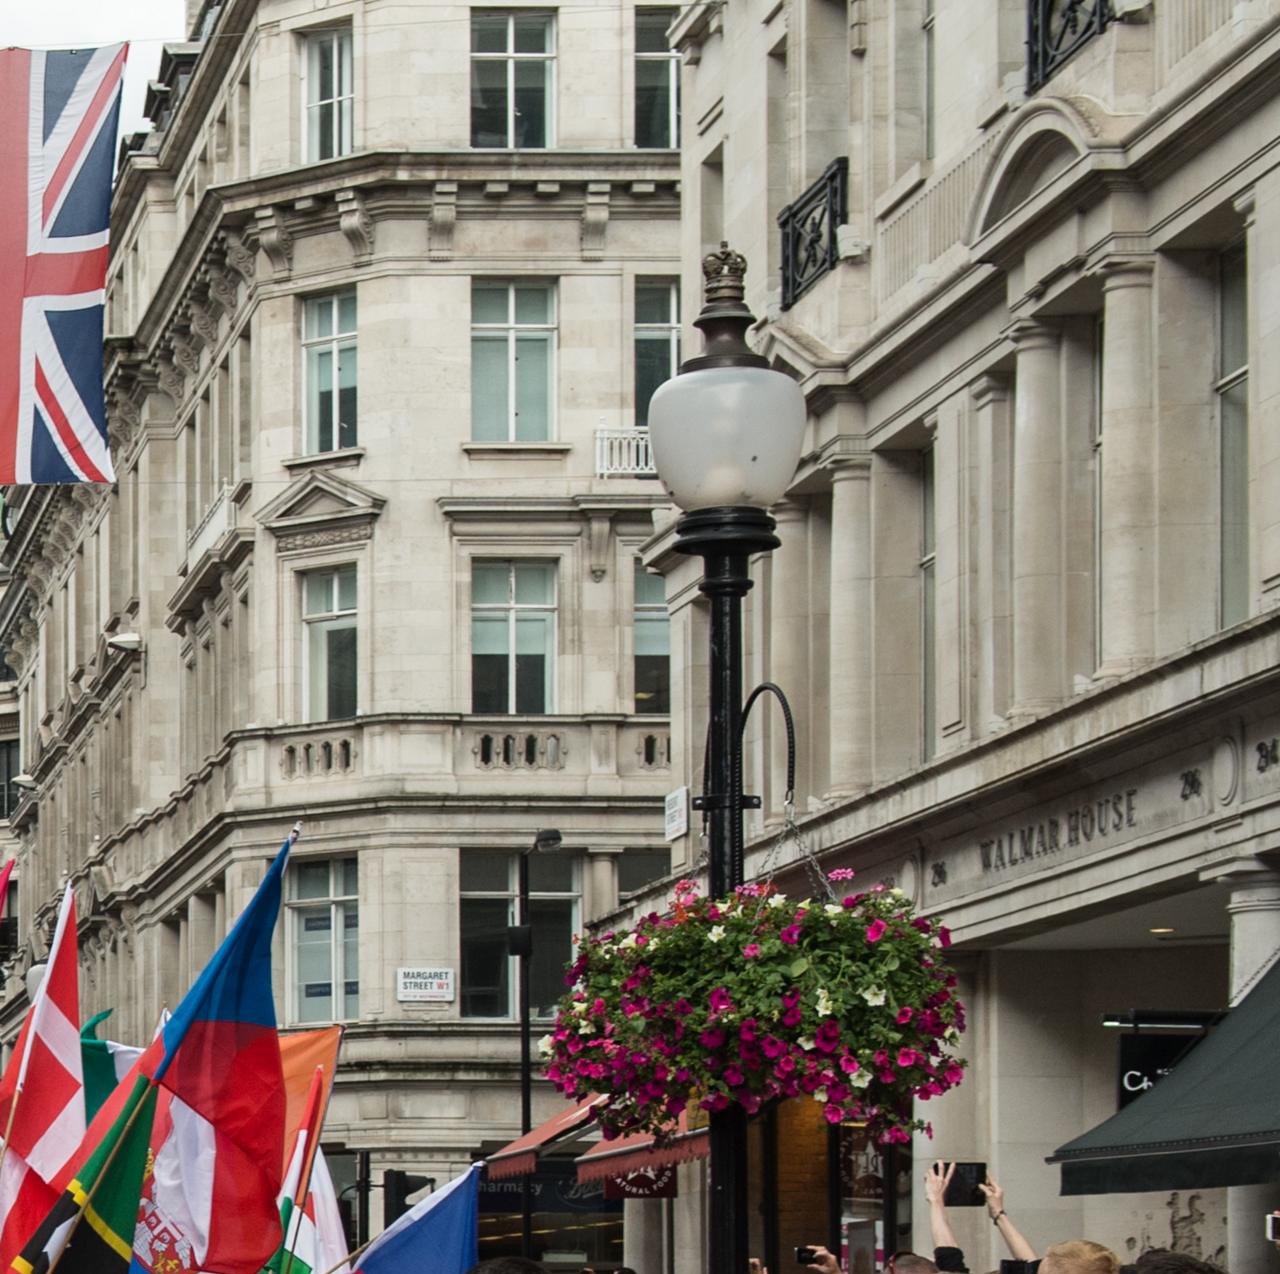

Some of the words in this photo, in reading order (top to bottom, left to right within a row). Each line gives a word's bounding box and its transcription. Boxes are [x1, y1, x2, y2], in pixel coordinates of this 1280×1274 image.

[979, 818, 1062, 871] WALMAR
[1067, 789, 1138, 847] HOUSE
[403, 971, 449, 980] MARGARET
[403, 982, 433, 990] STREET
[436, 982, 449, 990] W1
[478, 1182, 542, 1195] harmay
